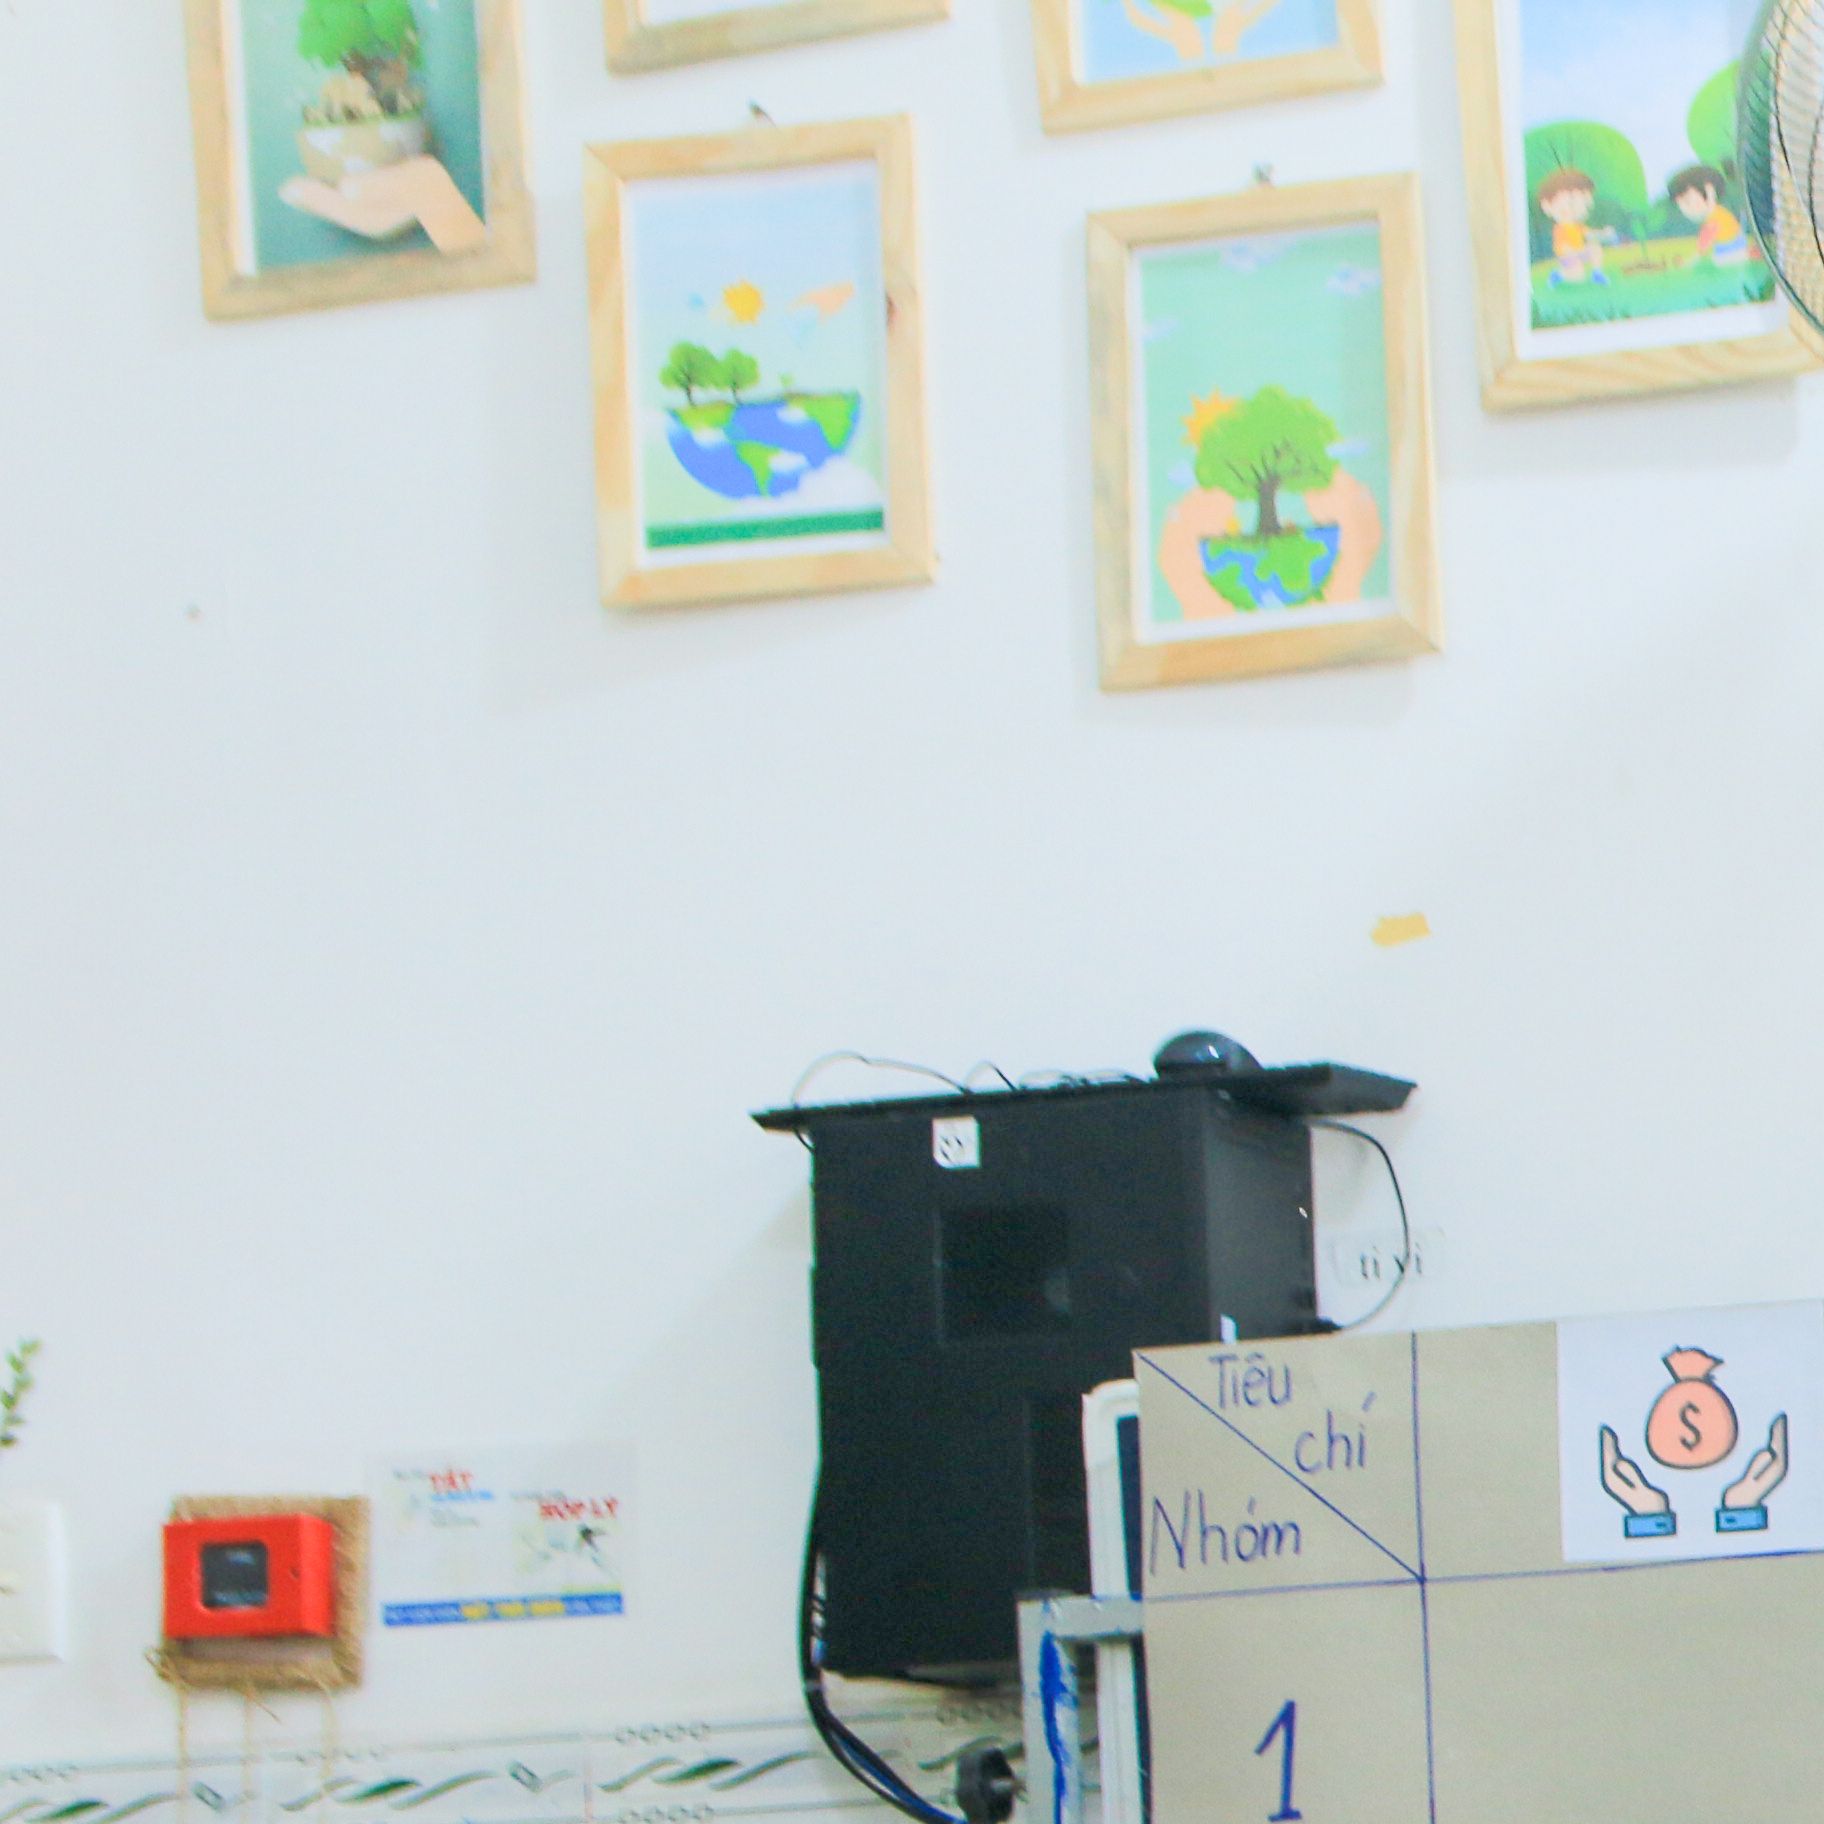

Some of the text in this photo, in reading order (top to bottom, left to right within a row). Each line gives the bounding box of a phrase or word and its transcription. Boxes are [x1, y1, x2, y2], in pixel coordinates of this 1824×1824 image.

[1208, 1350, 1294, 1410] Tiêu
[1294, 1391, 1376, 1475] chí
[1149, 1489, 1301, 1577] Nhóm
[1253, 1699, 1301, 1823] 1
